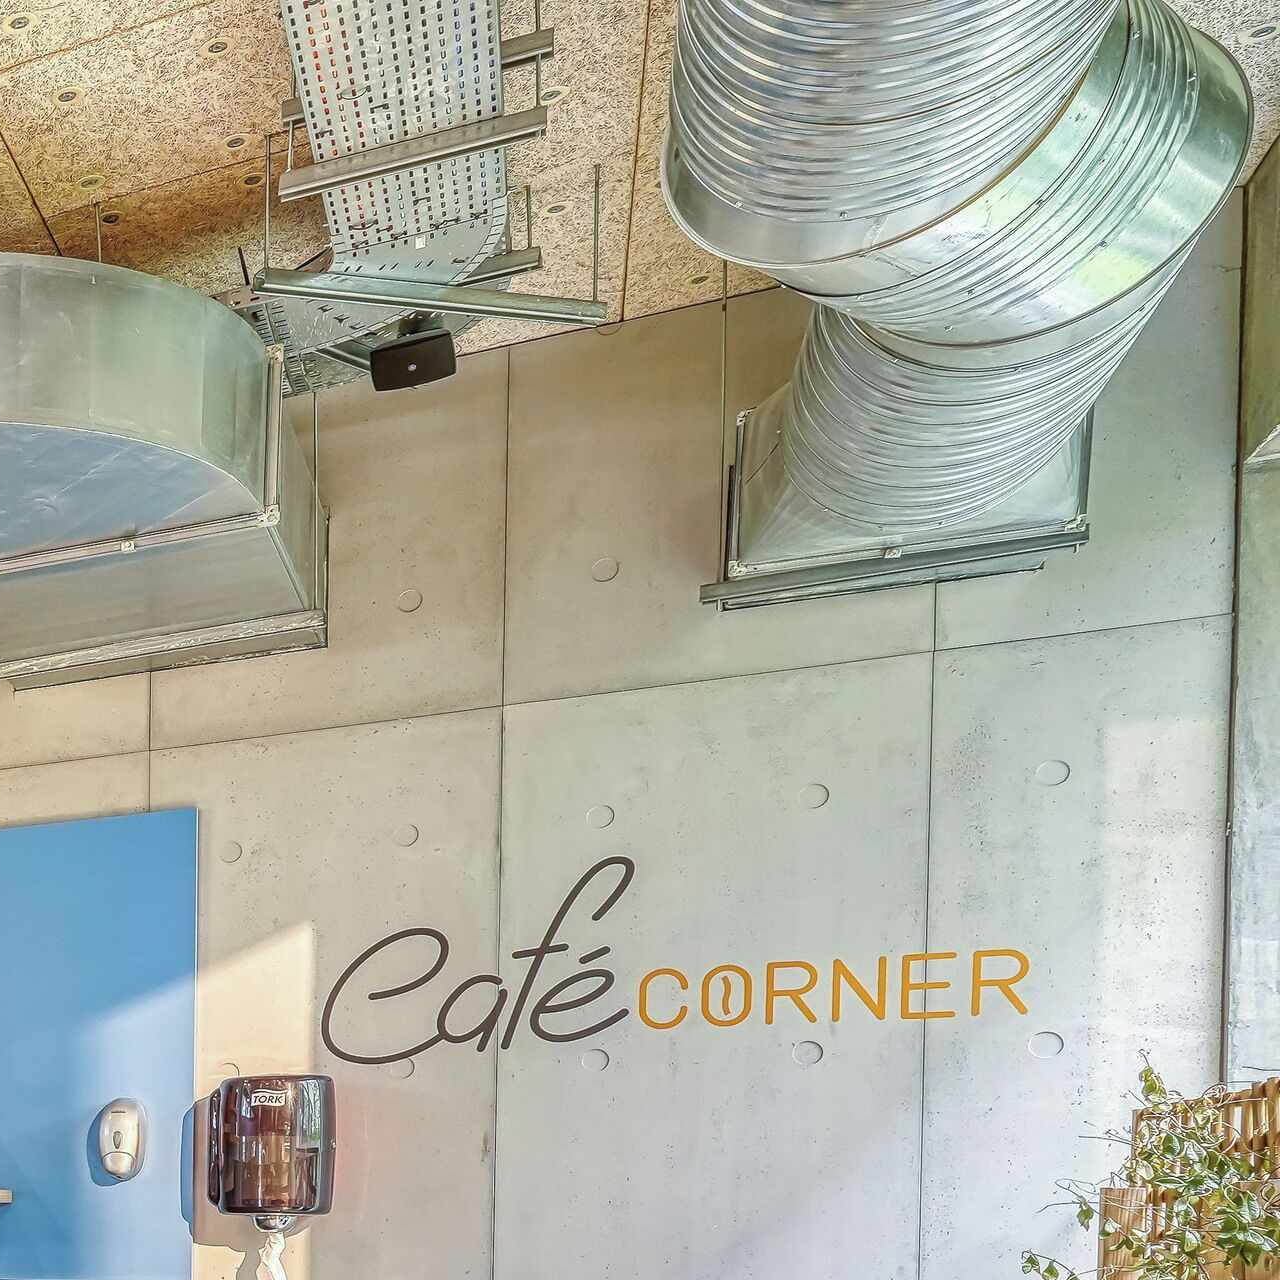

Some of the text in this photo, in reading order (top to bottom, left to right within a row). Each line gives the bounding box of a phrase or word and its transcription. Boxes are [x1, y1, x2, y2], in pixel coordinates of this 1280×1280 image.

[321, 854, 1030, 1065] Café CORNER
[253, 1095, 283, 1104] TORK
